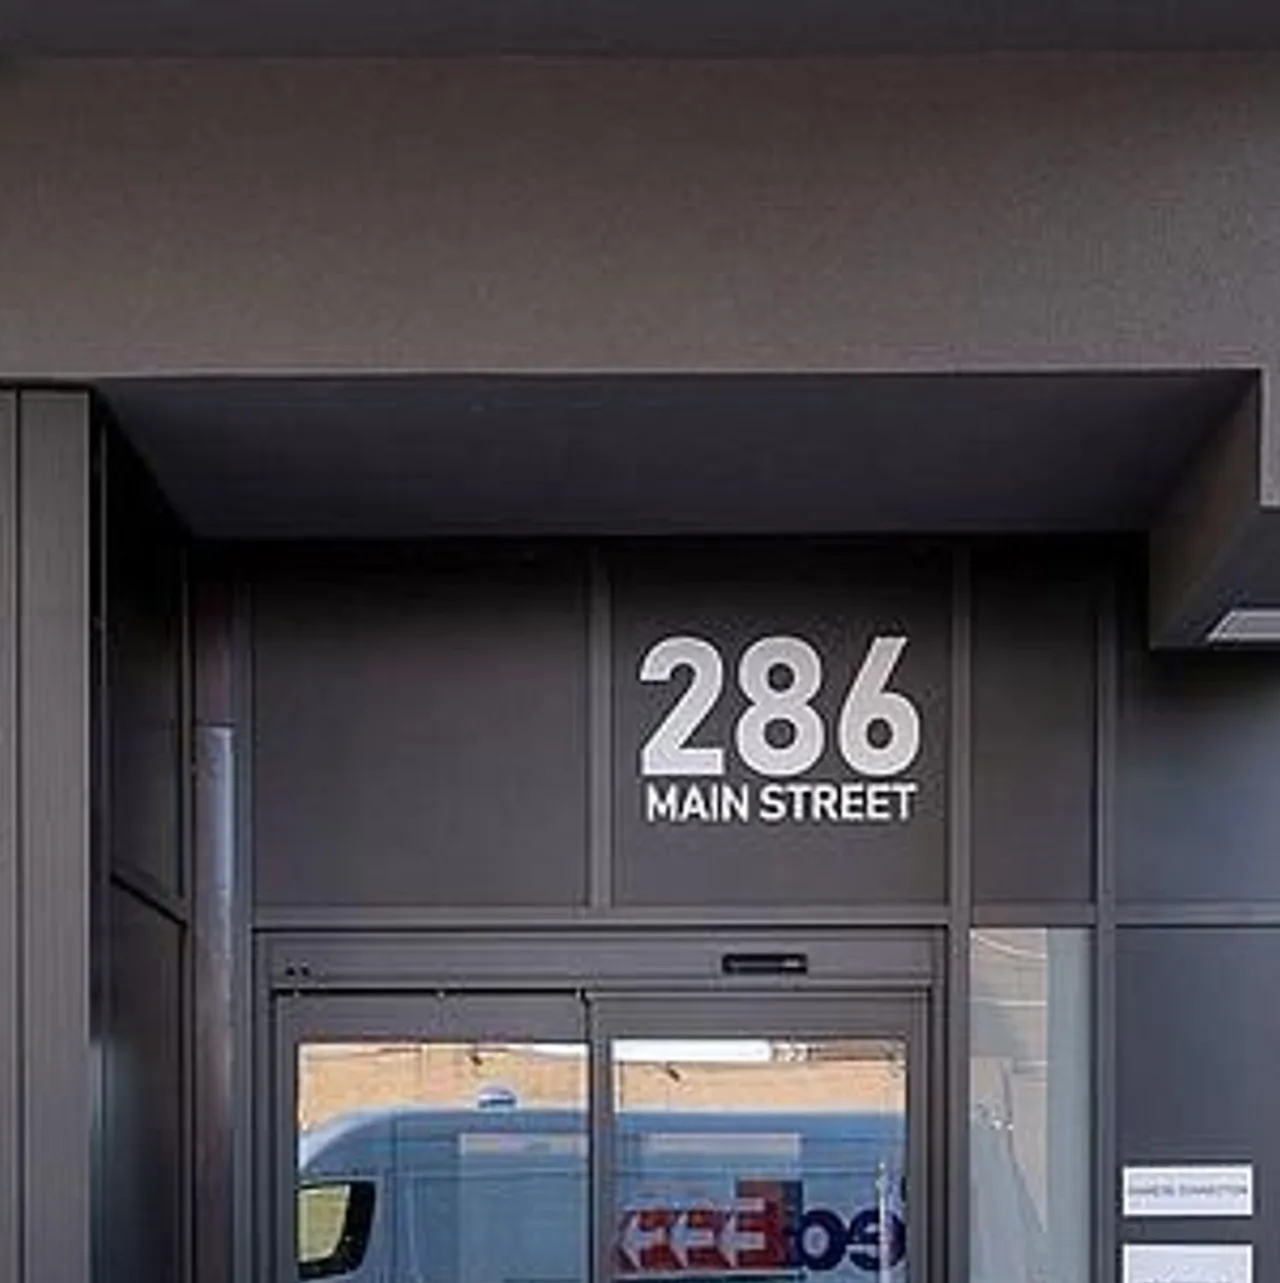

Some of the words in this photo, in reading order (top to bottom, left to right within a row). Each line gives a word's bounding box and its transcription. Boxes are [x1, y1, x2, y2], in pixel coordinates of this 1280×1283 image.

[640, 635, 920, 776] 286
[646, 783, 749, 822] MAIN
[759, 782, 918, 821] STREET
